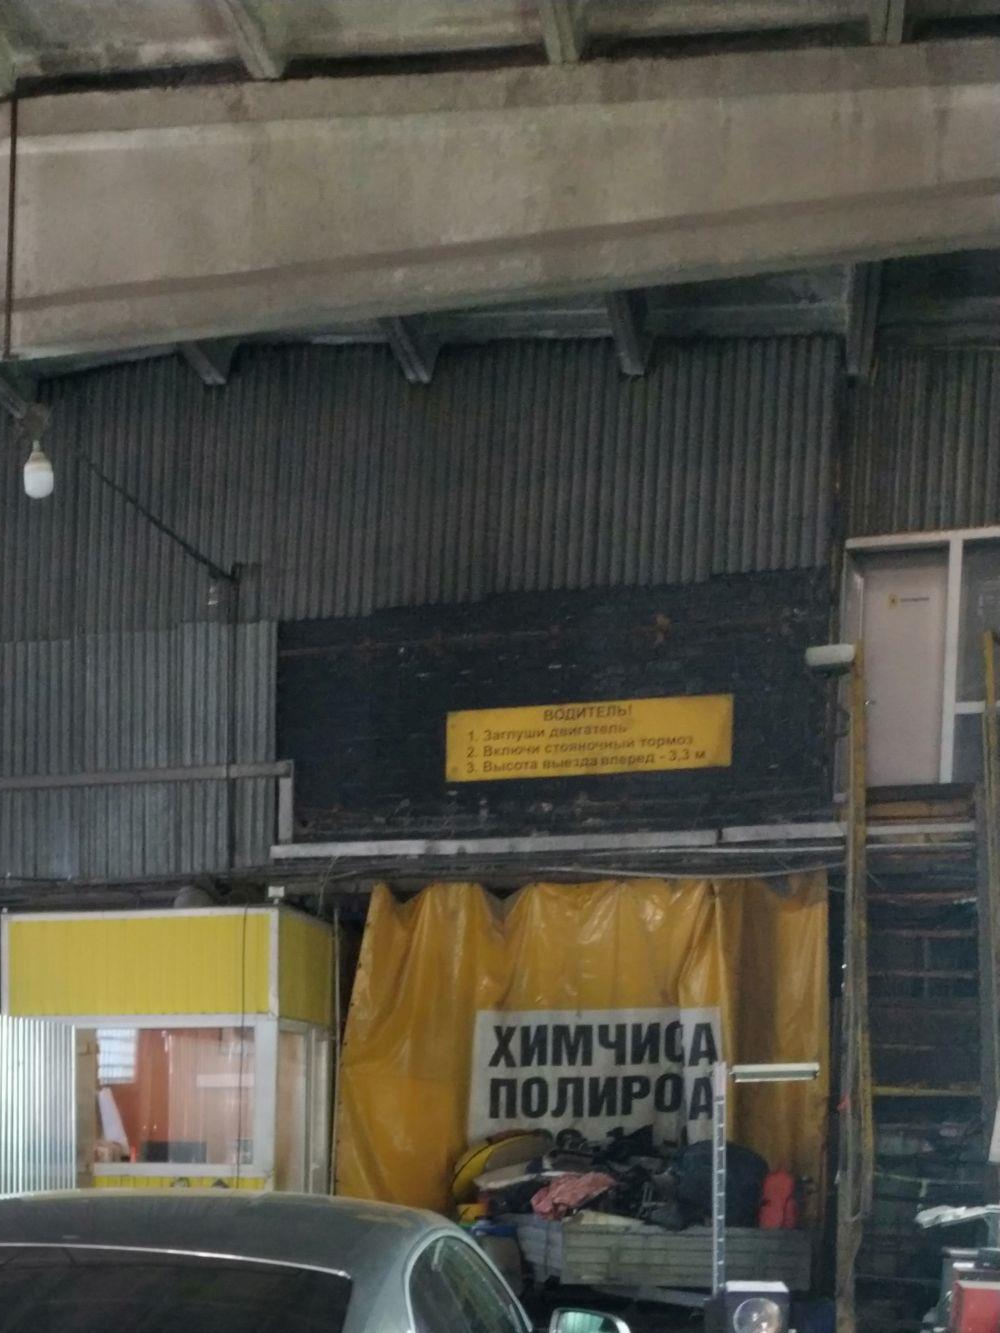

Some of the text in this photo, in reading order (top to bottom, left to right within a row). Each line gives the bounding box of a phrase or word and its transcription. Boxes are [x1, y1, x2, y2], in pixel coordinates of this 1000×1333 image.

[543, 704, 633, 722] ВОДИТЕЛЬ!
[468, 724, 628, 742] 1. Заглуши двигатель
[467, 735, 694, 758] 2. Включи стояночный тормоз
[466, 762, 478, 773] 3.
[483, 760, 538, 772] Высота
[543, 756, 598, 769] выезда
[601, 753, 655, 767] вперед
